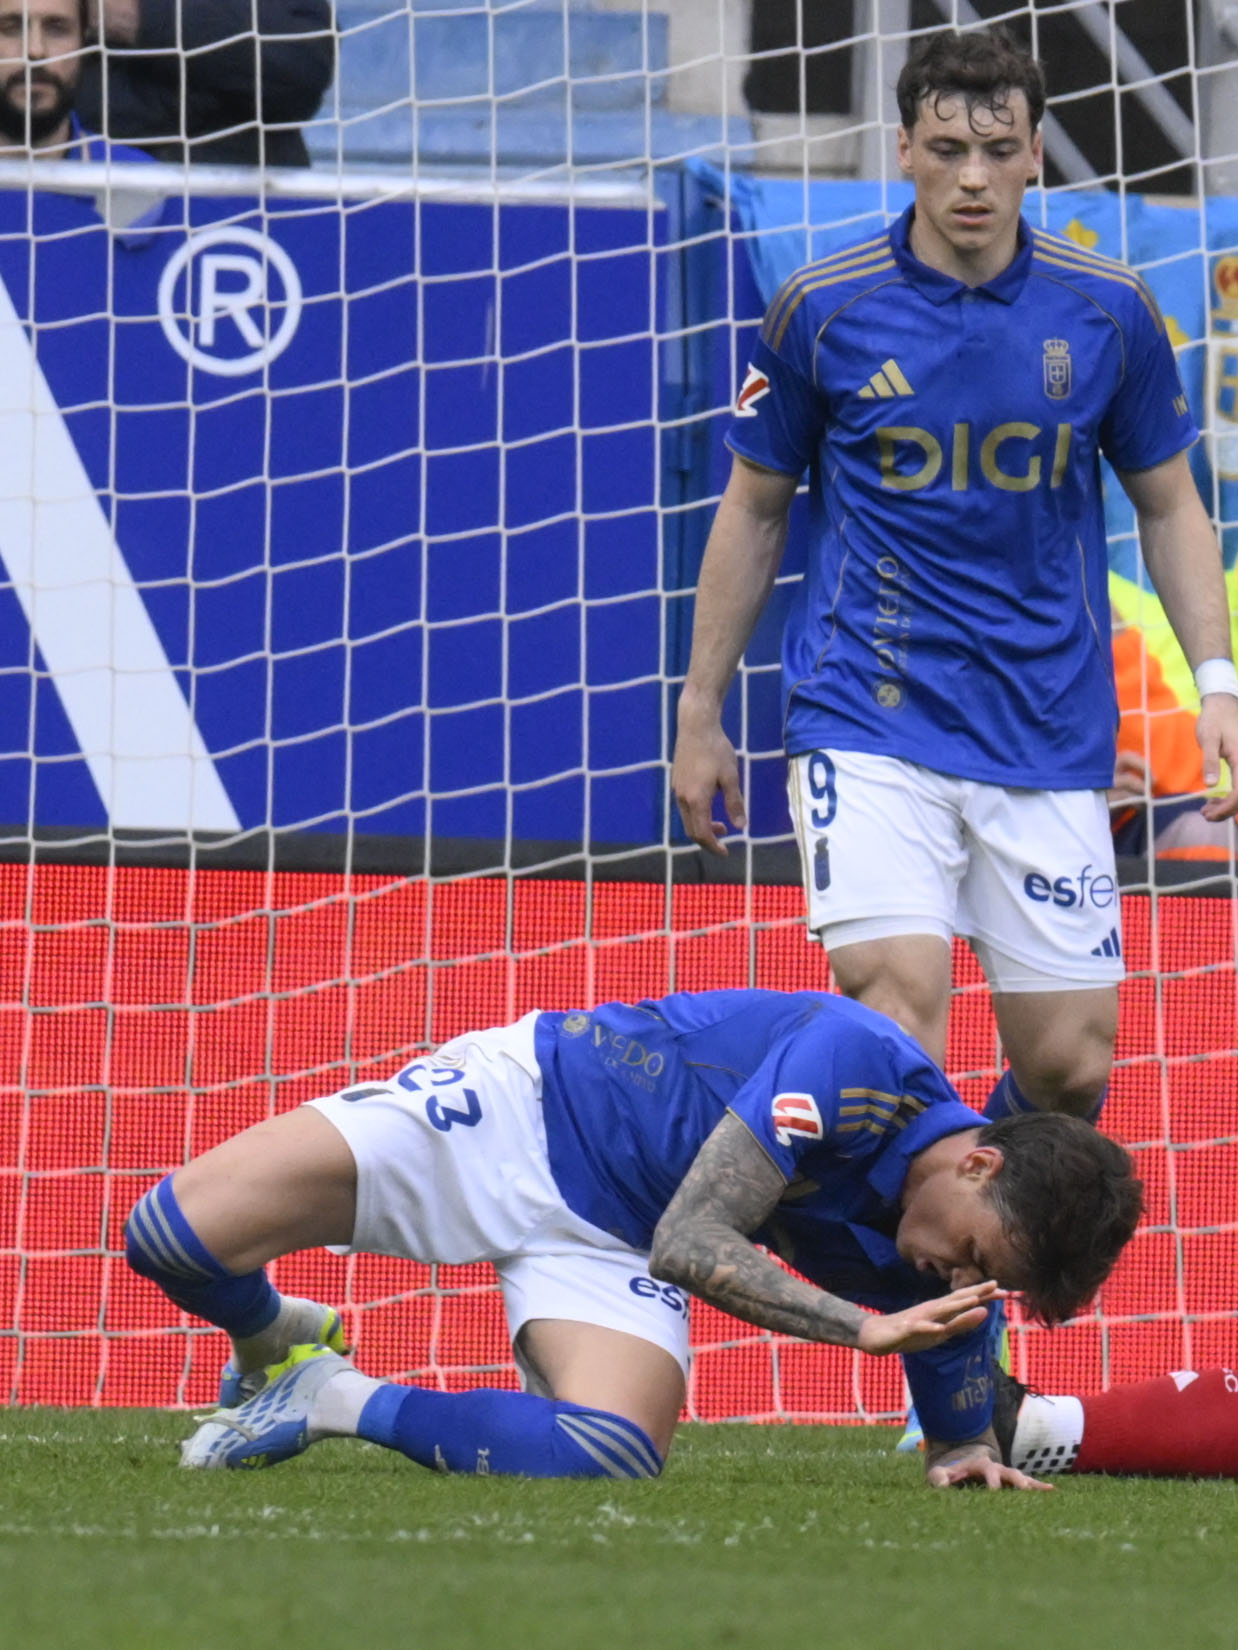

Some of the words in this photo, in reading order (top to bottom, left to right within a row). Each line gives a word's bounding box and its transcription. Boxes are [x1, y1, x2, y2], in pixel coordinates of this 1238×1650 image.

[876, 421, 1072, 492] DIGI
[808, 751, 838, 829] 9
[1023, 864, 1118, 908] esfe
